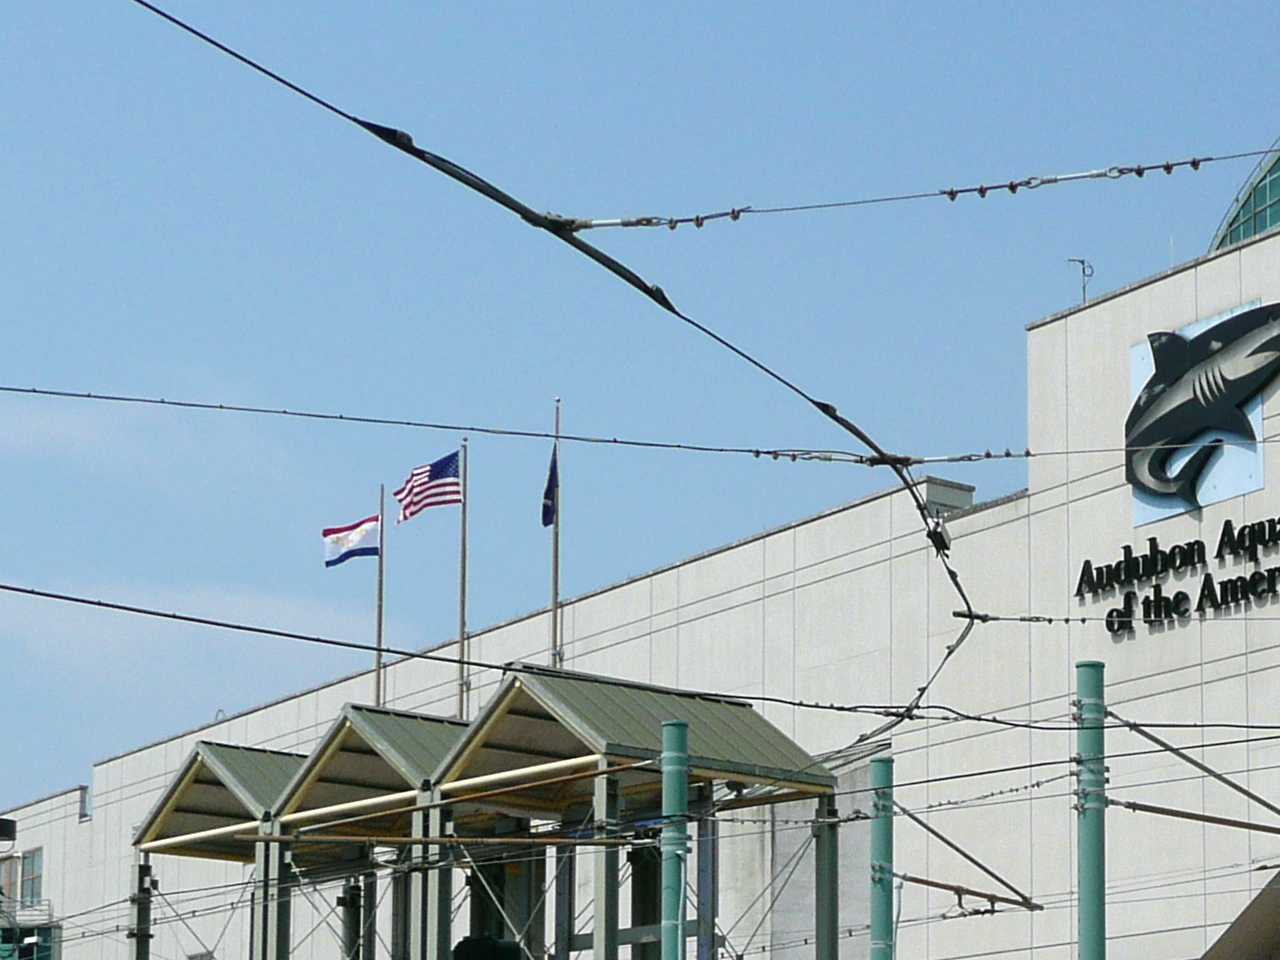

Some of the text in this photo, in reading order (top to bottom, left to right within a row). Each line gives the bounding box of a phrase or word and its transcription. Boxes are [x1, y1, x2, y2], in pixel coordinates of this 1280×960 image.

[1074, 536, 1207, 597] Audubon
[1105, 590, 1137, 635] of
[1141, 583, 1191, 624] the
